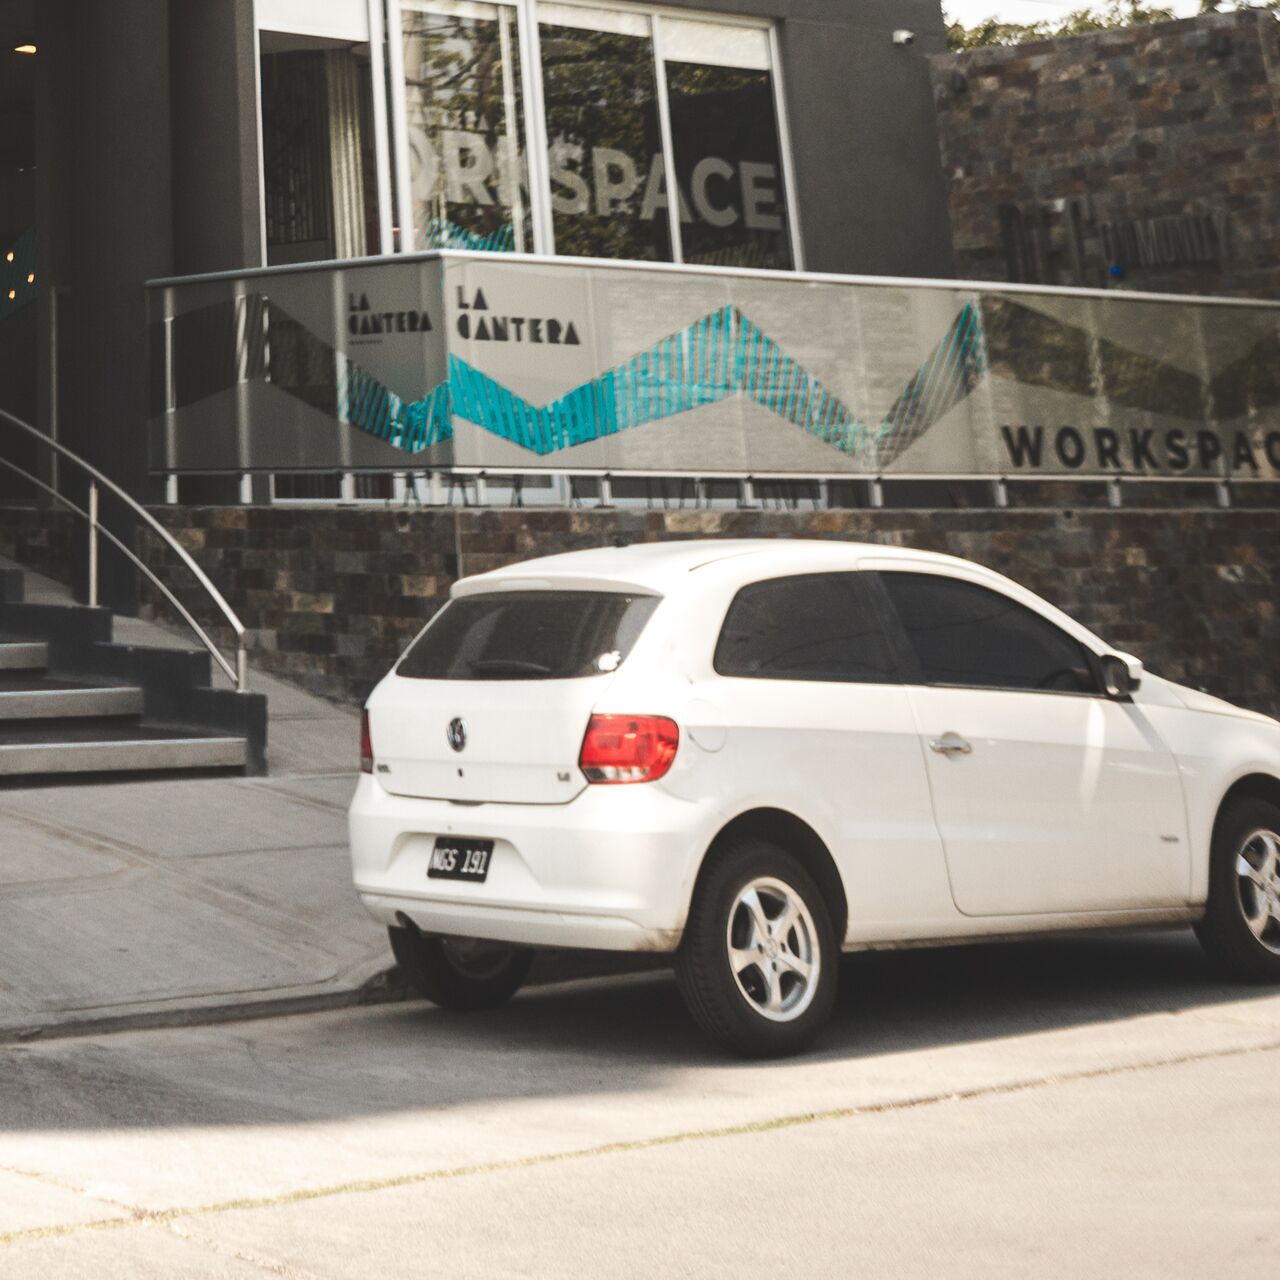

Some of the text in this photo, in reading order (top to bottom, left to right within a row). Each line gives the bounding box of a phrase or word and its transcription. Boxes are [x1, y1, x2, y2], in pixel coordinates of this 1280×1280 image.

[349, 293, 370, 311] LA
[457, 285, 488, 310] LA
[348, 311, 432, 335] CANTERA
[457, 313, 581, 345] CANTERA
[461, 850, 488, 875] 191
